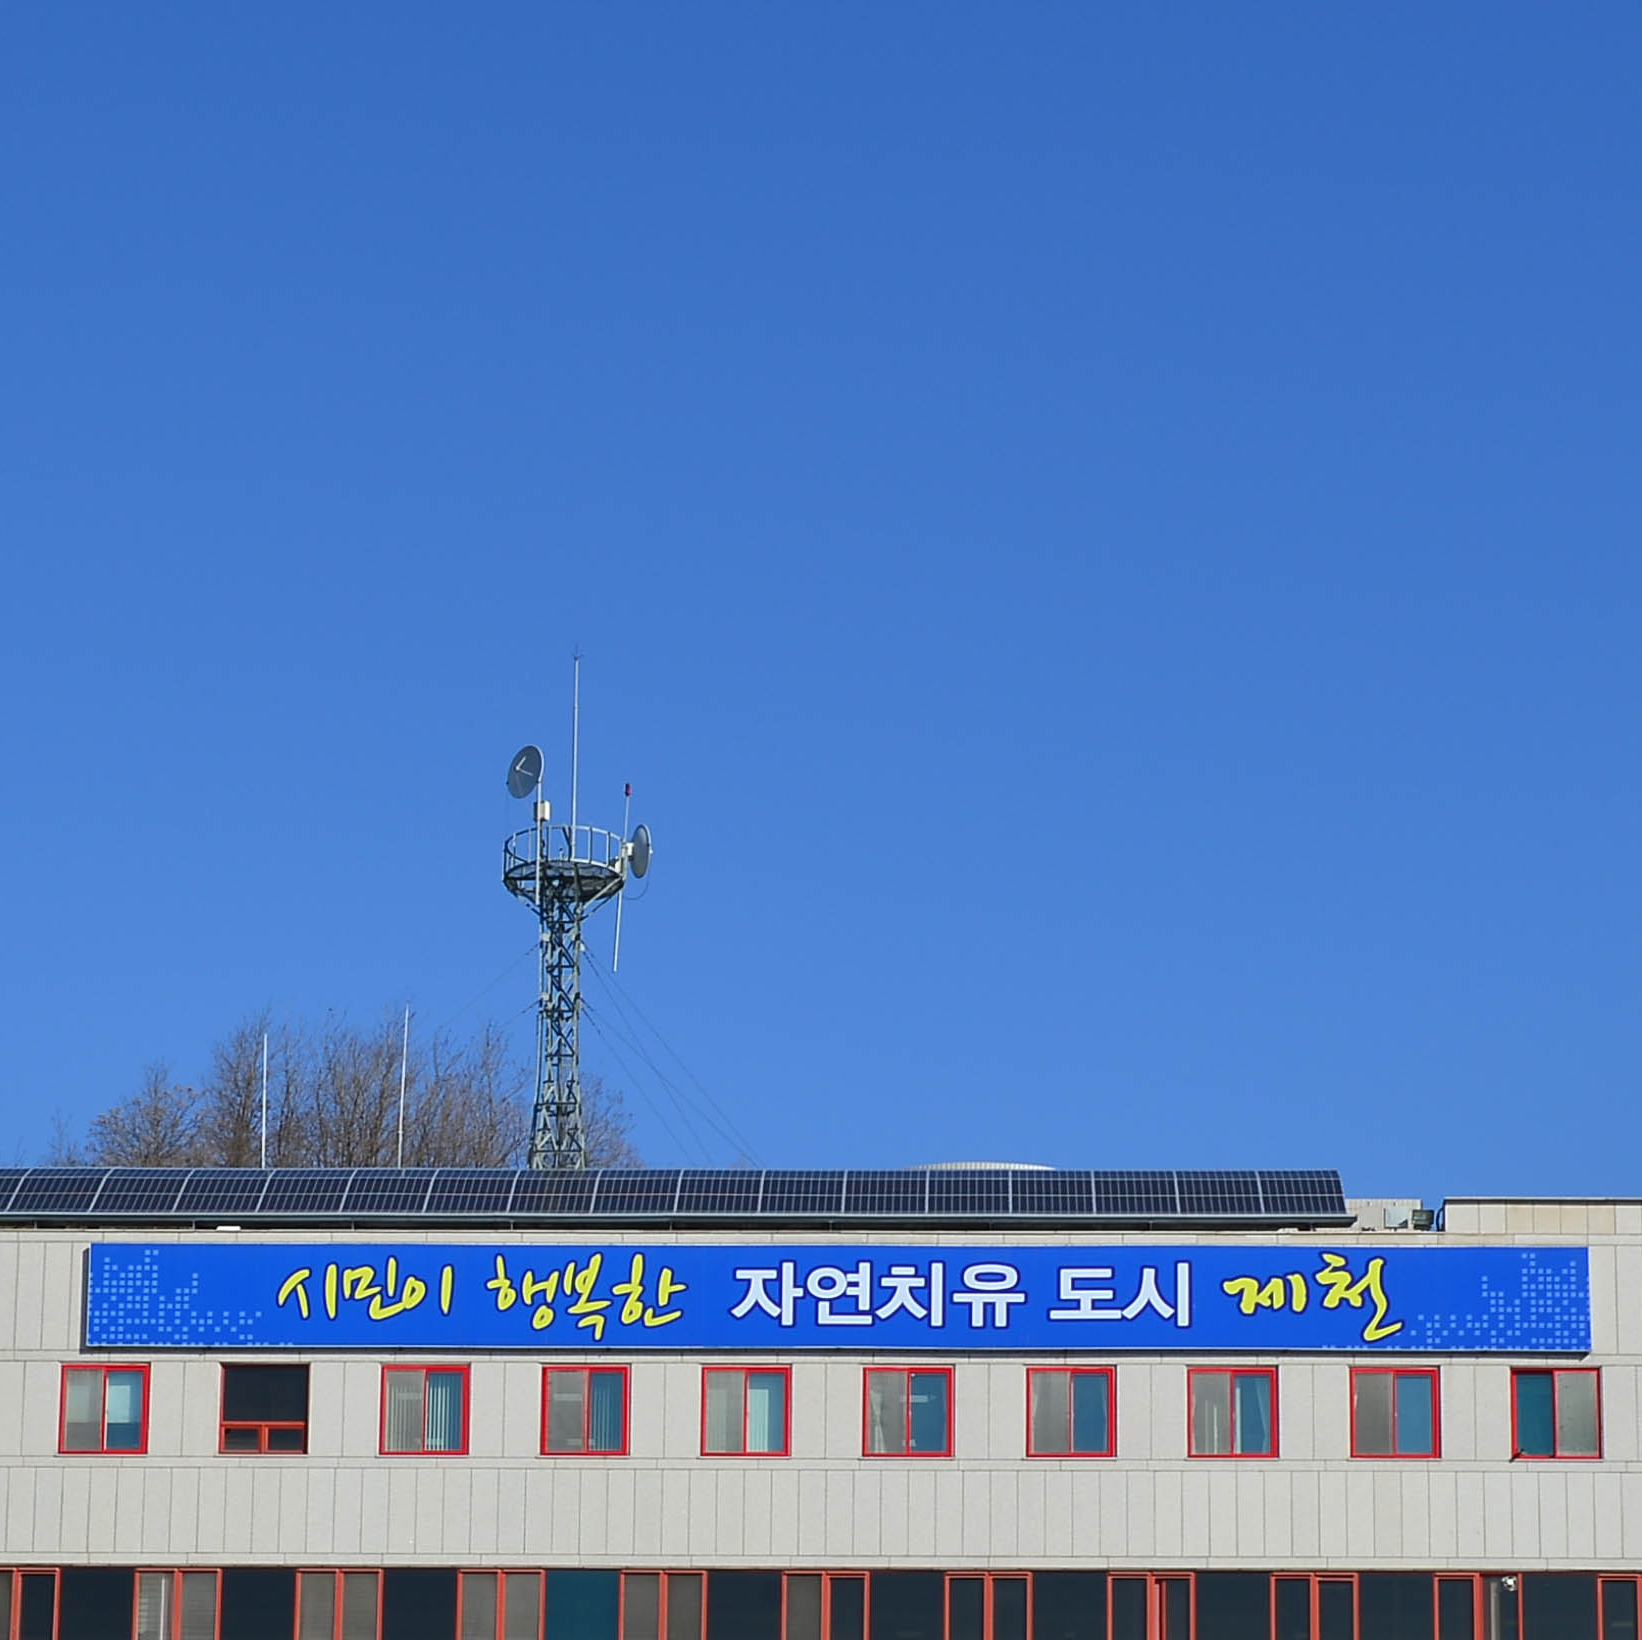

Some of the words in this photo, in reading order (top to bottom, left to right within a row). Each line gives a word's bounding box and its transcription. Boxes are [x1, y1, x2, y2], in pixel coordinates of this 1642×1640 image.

[278, 1255, 453, 1321] 시민이
[487, 1252, 688, 1341] 행복한
[730, 1260, 1026, 1328] 자연치유
[1048, 1260, 1193, 1328] 도시
[1223, 1252, 1403, 1341] 제천
